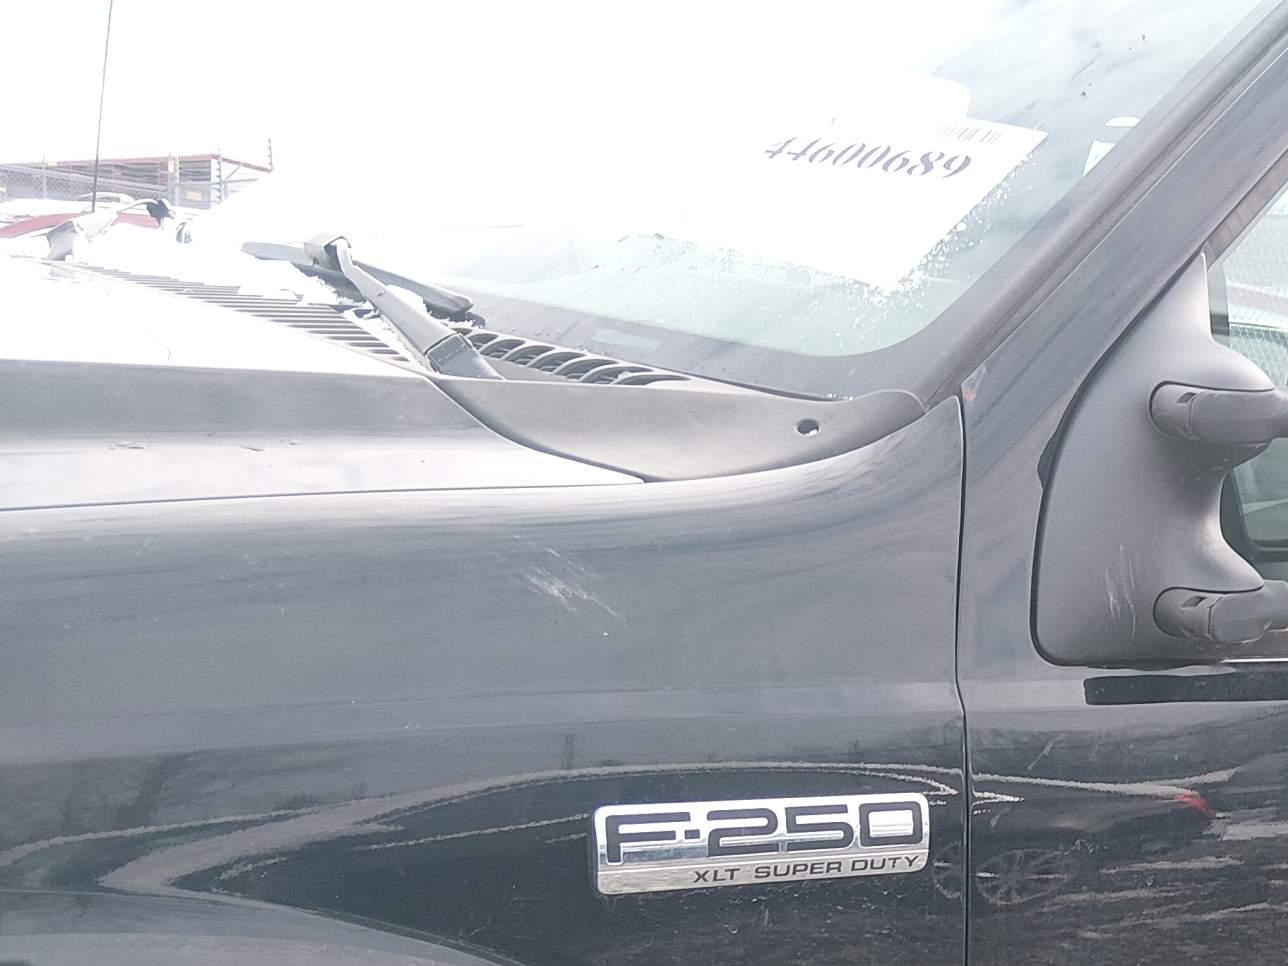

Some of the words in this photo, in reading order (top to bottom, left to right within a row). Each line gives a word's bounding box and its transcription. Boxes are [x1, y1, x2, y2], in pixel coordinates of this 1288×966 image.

[765, 136, 971, 178] 44600689
[693, 868, 741, 883] XLT
[754, 861, 843, 879] SUPER
[851, 855, 919, 872] DUTY
